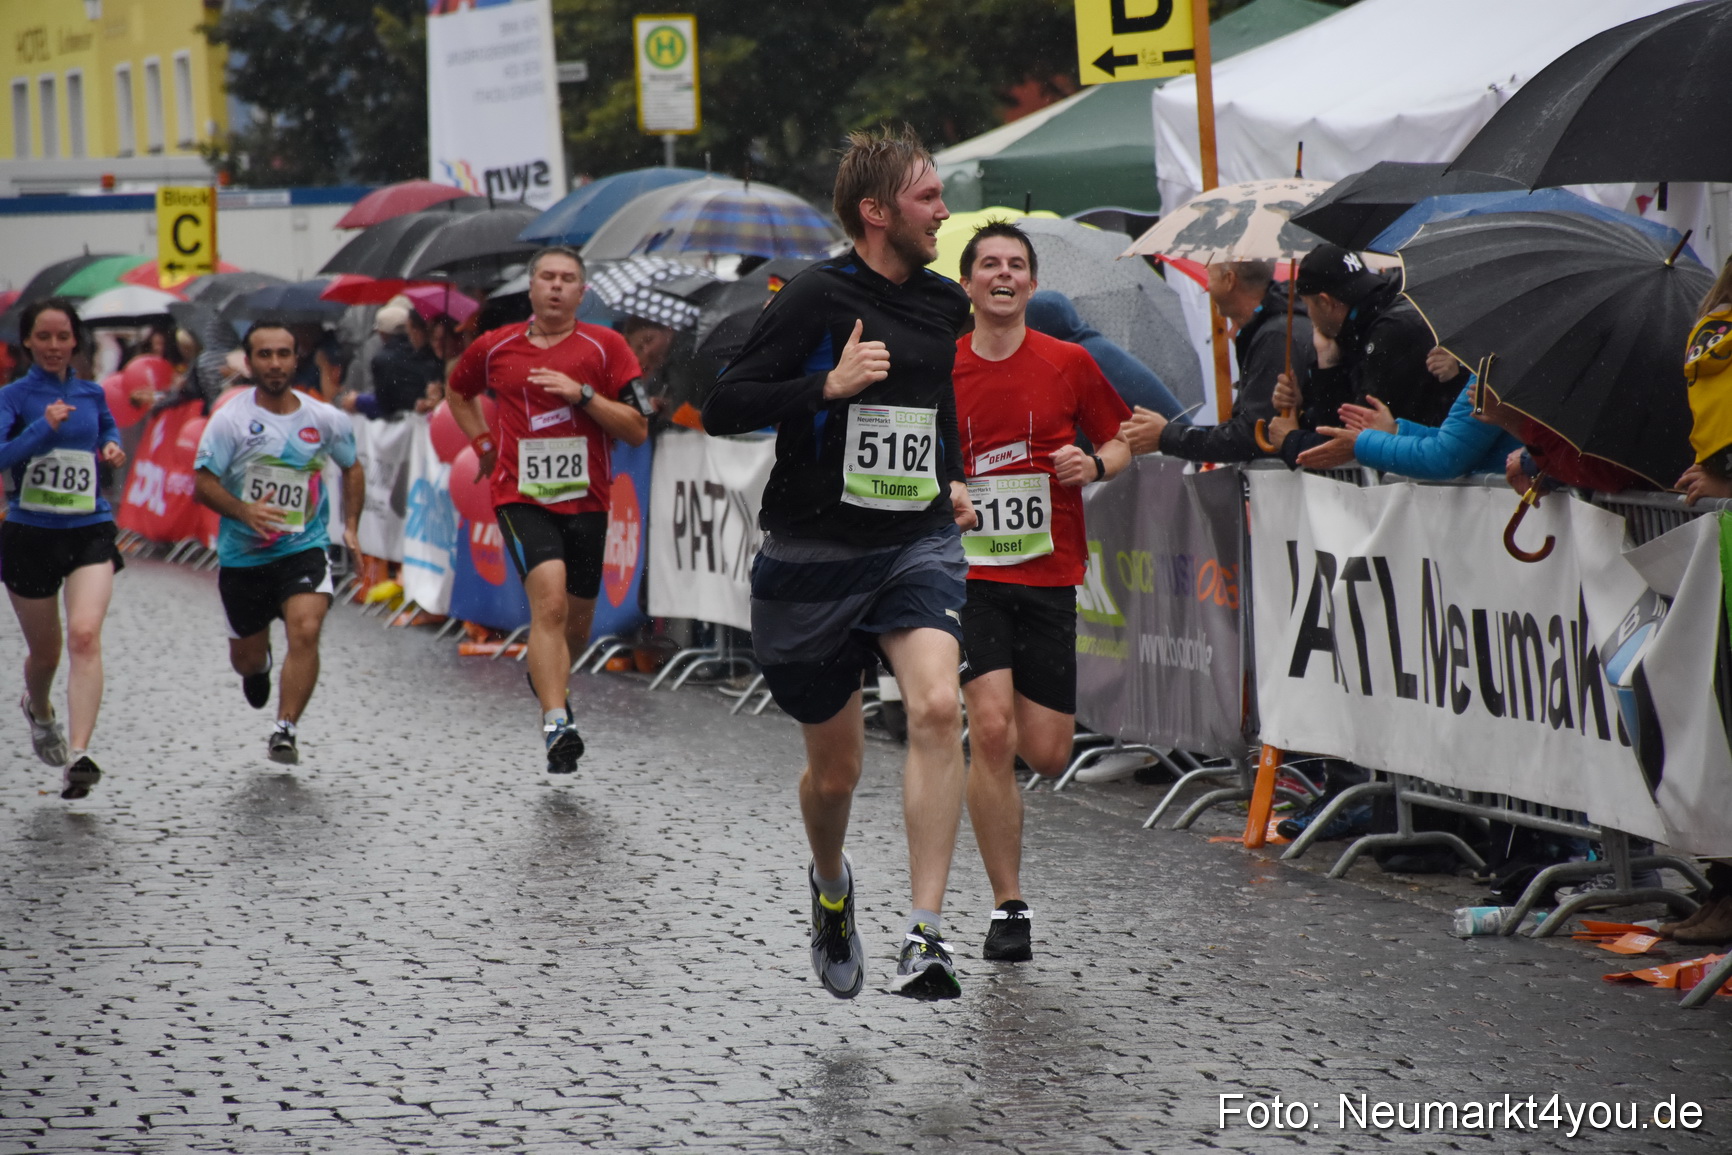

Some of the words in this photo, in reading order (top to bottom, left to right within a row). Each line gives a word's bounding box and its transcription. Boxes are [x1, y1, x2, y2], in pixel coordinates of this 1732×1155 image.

[173, 213, 201, 254] C
[857, 431, 931, 472] 5162
[989, 450, 1013, 465] DEHN
[31, 463, 90, 493] 5183
[527, 454, 582, 479] 5128
[250, 478, 303, 508] 5203
[872, 480, 919, 497] Thomas
[997, 478, 1041, 490] BOCK
[970, 496, 1044, 532] 5136
[990, 539, 1022, 553] Josef
